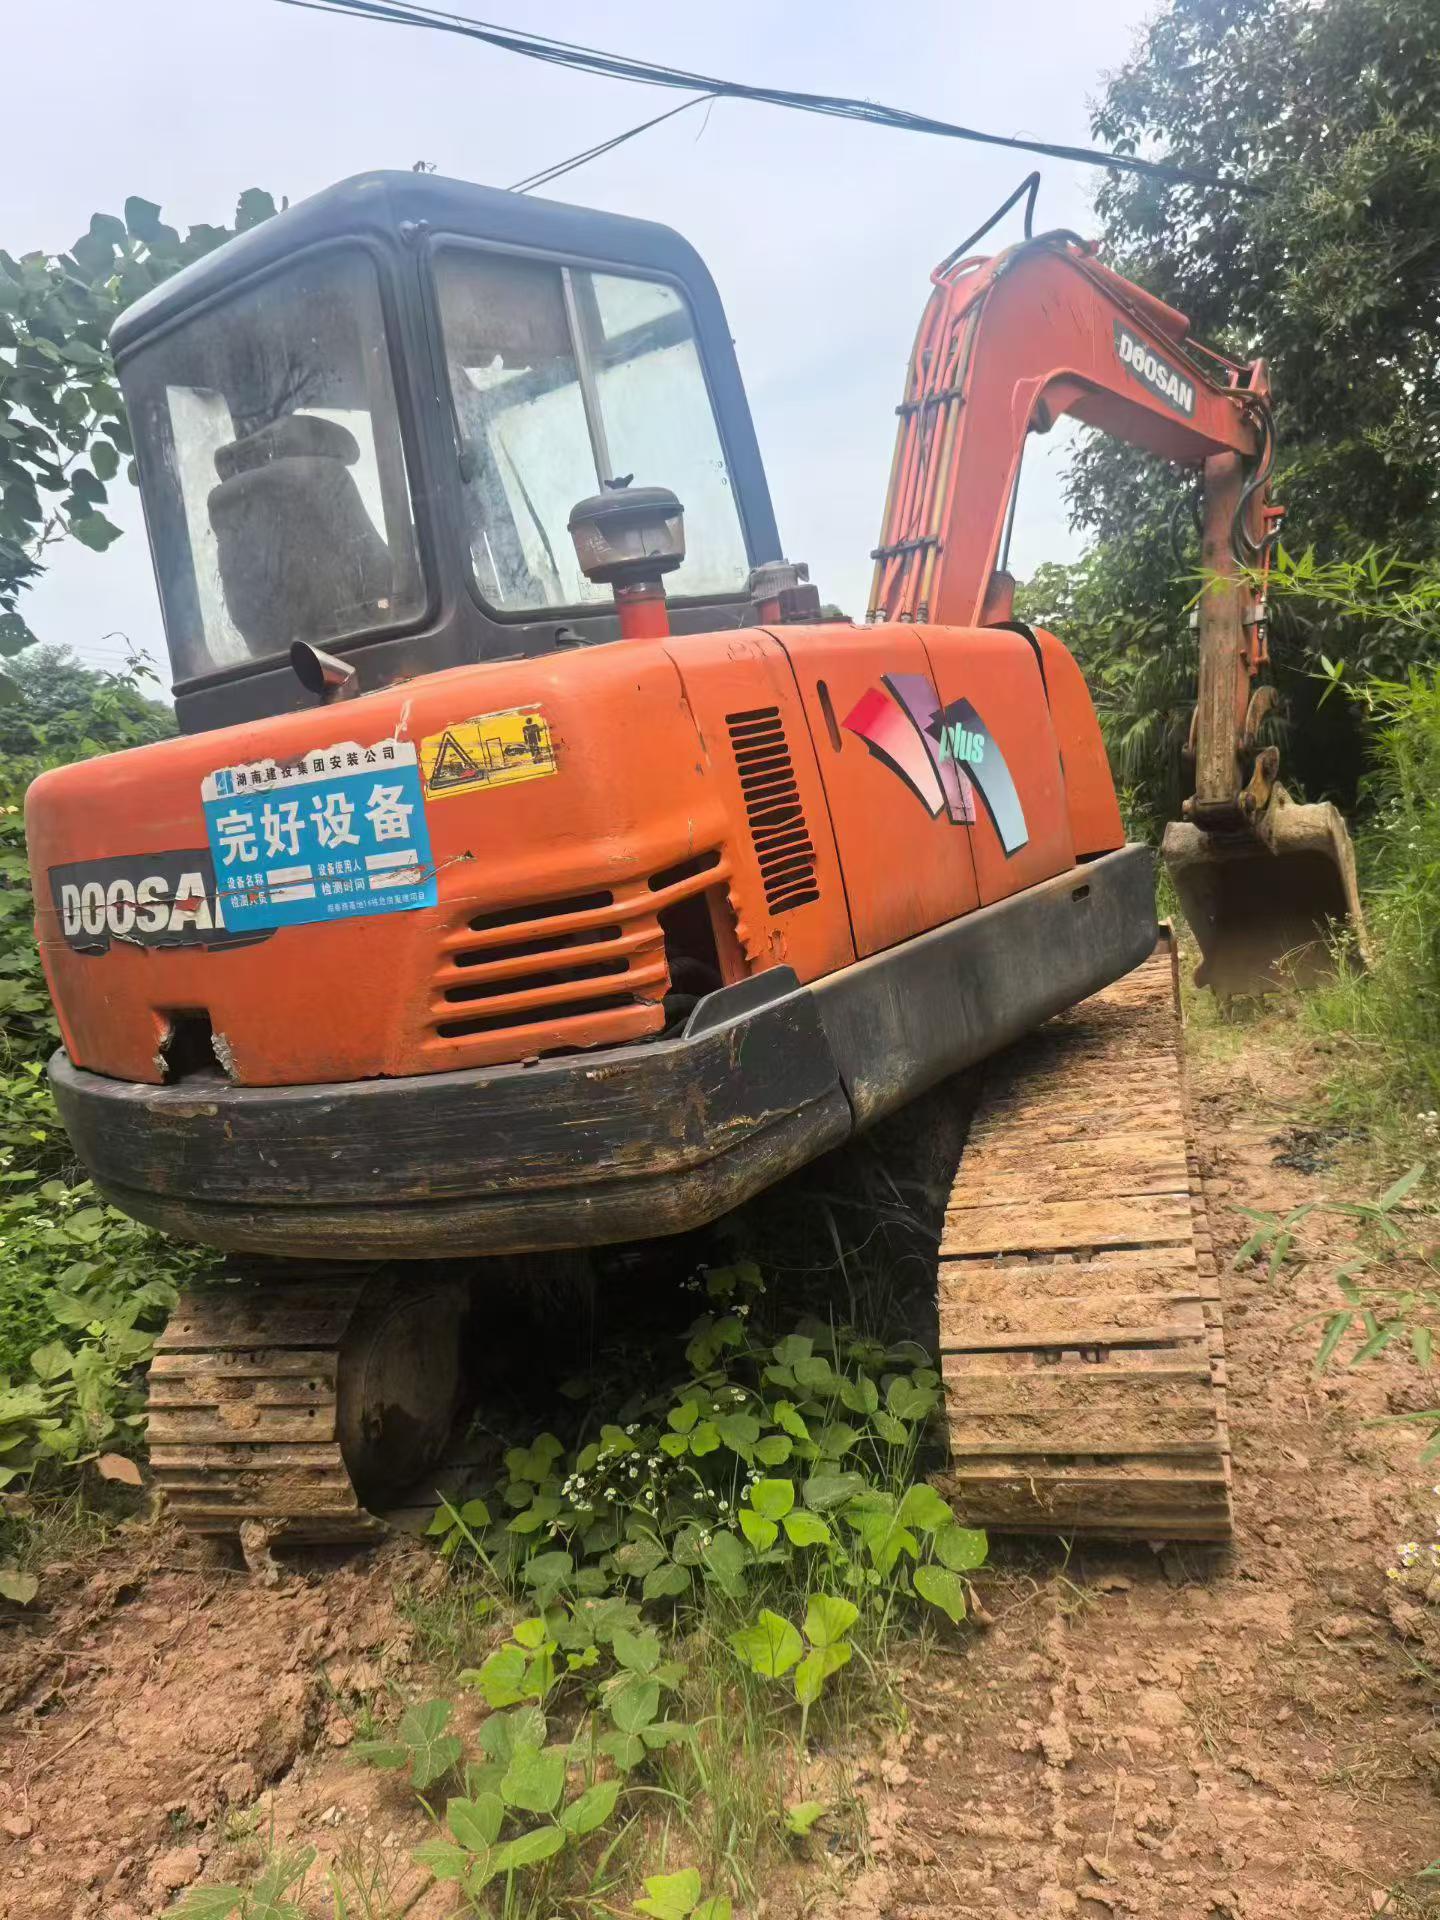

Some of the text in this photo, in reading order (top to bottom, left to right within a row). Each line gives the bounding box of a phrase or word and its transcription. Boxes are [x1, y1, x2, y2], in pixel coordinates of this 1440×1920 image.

[1119, 333, 1192, 412] DOOSAN
[938, 722, 984, 764] plus
[215, 784, 414, 866] 完好设备
[226, 872, 264, 890] 设备名称
[317, 858, 362, 877] 设备使用人
[320, 878, 366, 897] 检测时间
